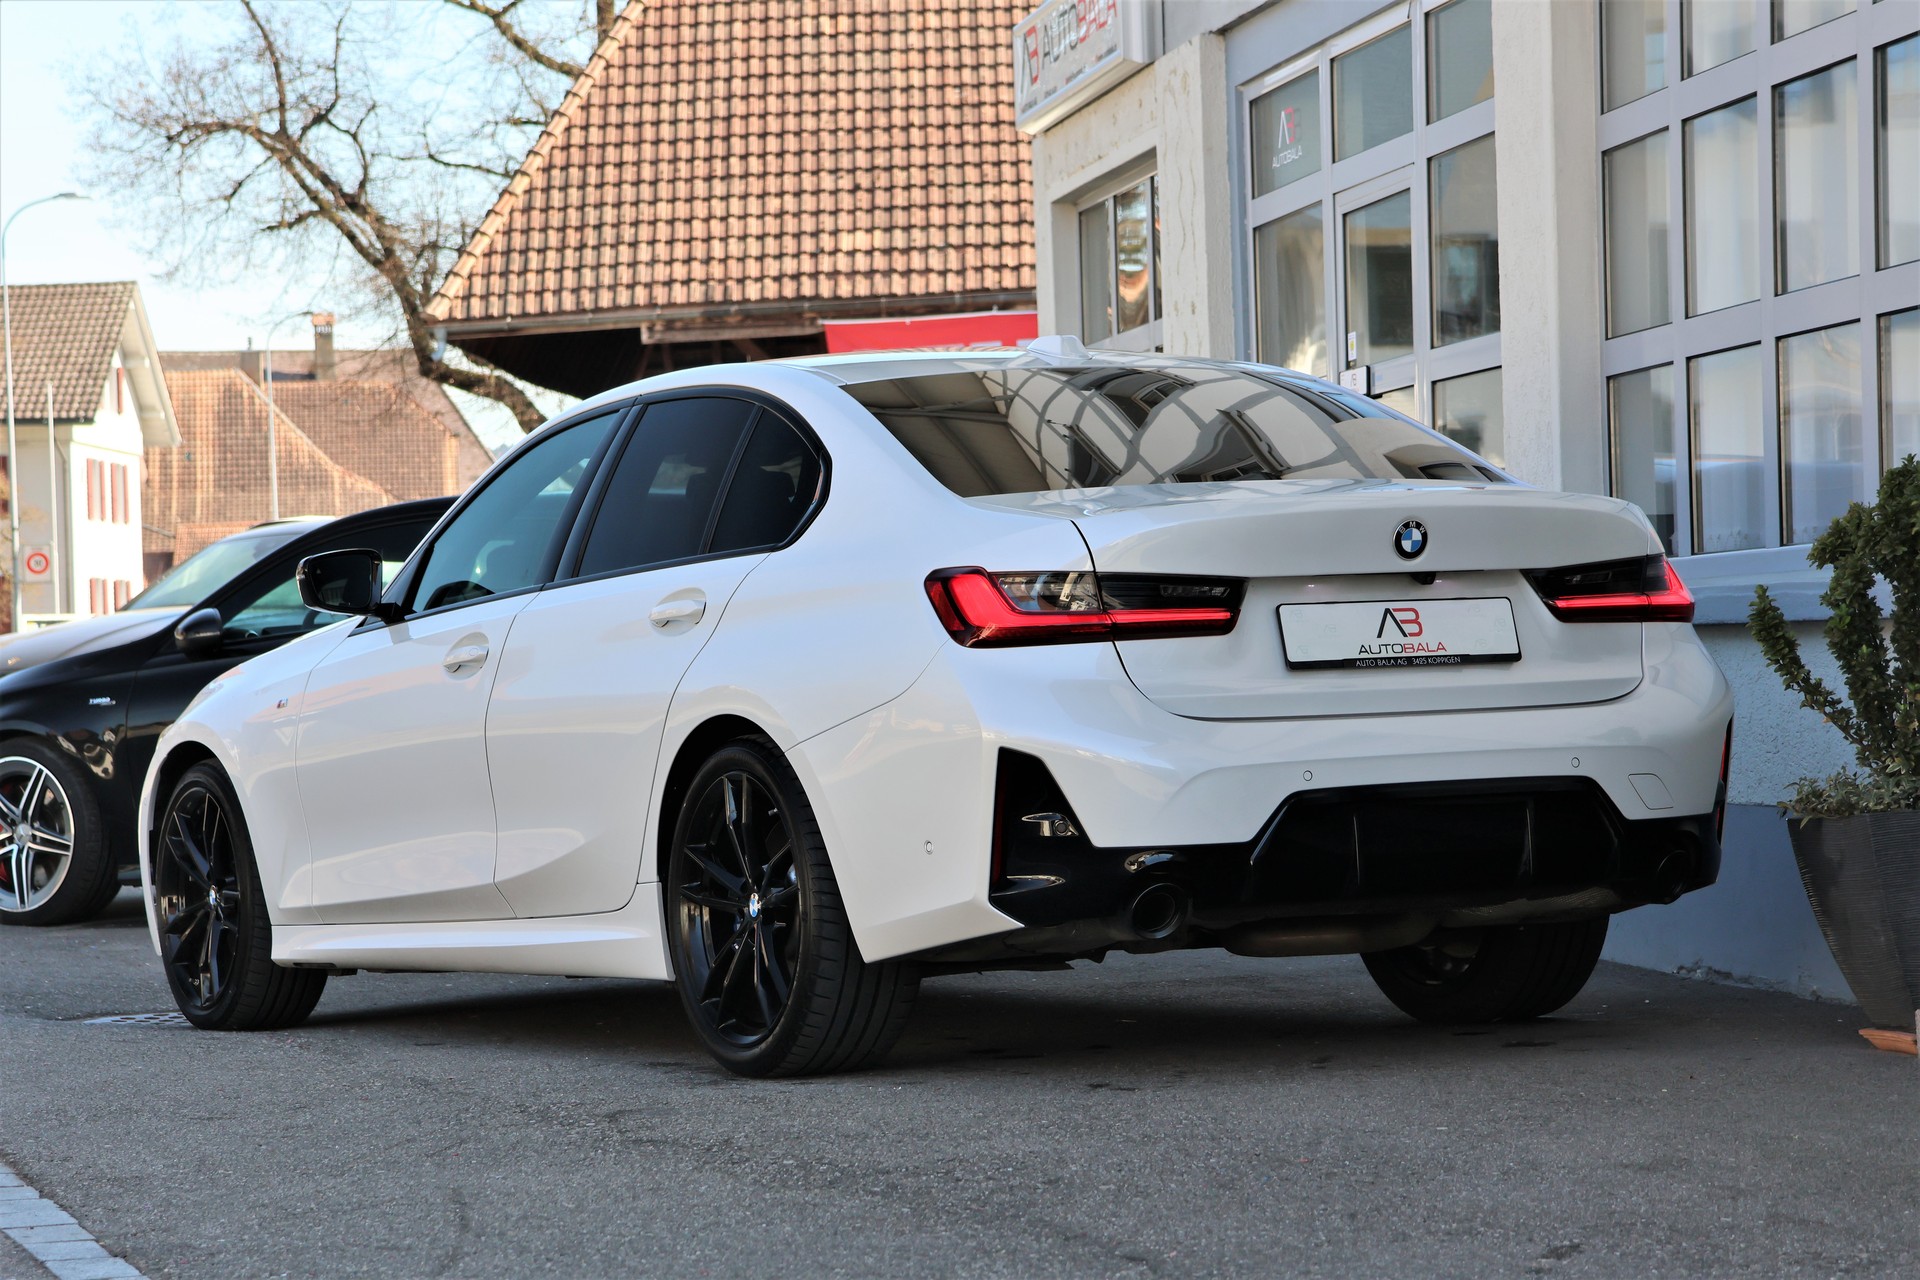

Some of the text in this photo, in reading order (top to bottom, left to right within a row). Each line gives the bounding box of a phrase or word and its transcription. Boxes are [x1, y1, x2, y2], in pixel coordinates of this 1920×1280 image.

[1272, 145, 1302, 169] AUTOBALA
[1399, 521, 1426, 534] BMW
[1358, 641, 1447, 655] AUTOBALA
[1356, 659, 1375, 667] AUTO
[1377, 658, 1396, 666] BALA
[1397, 658, 1408, 666] AG
[1428, 656, 1461, 664] KOPPIGEN
